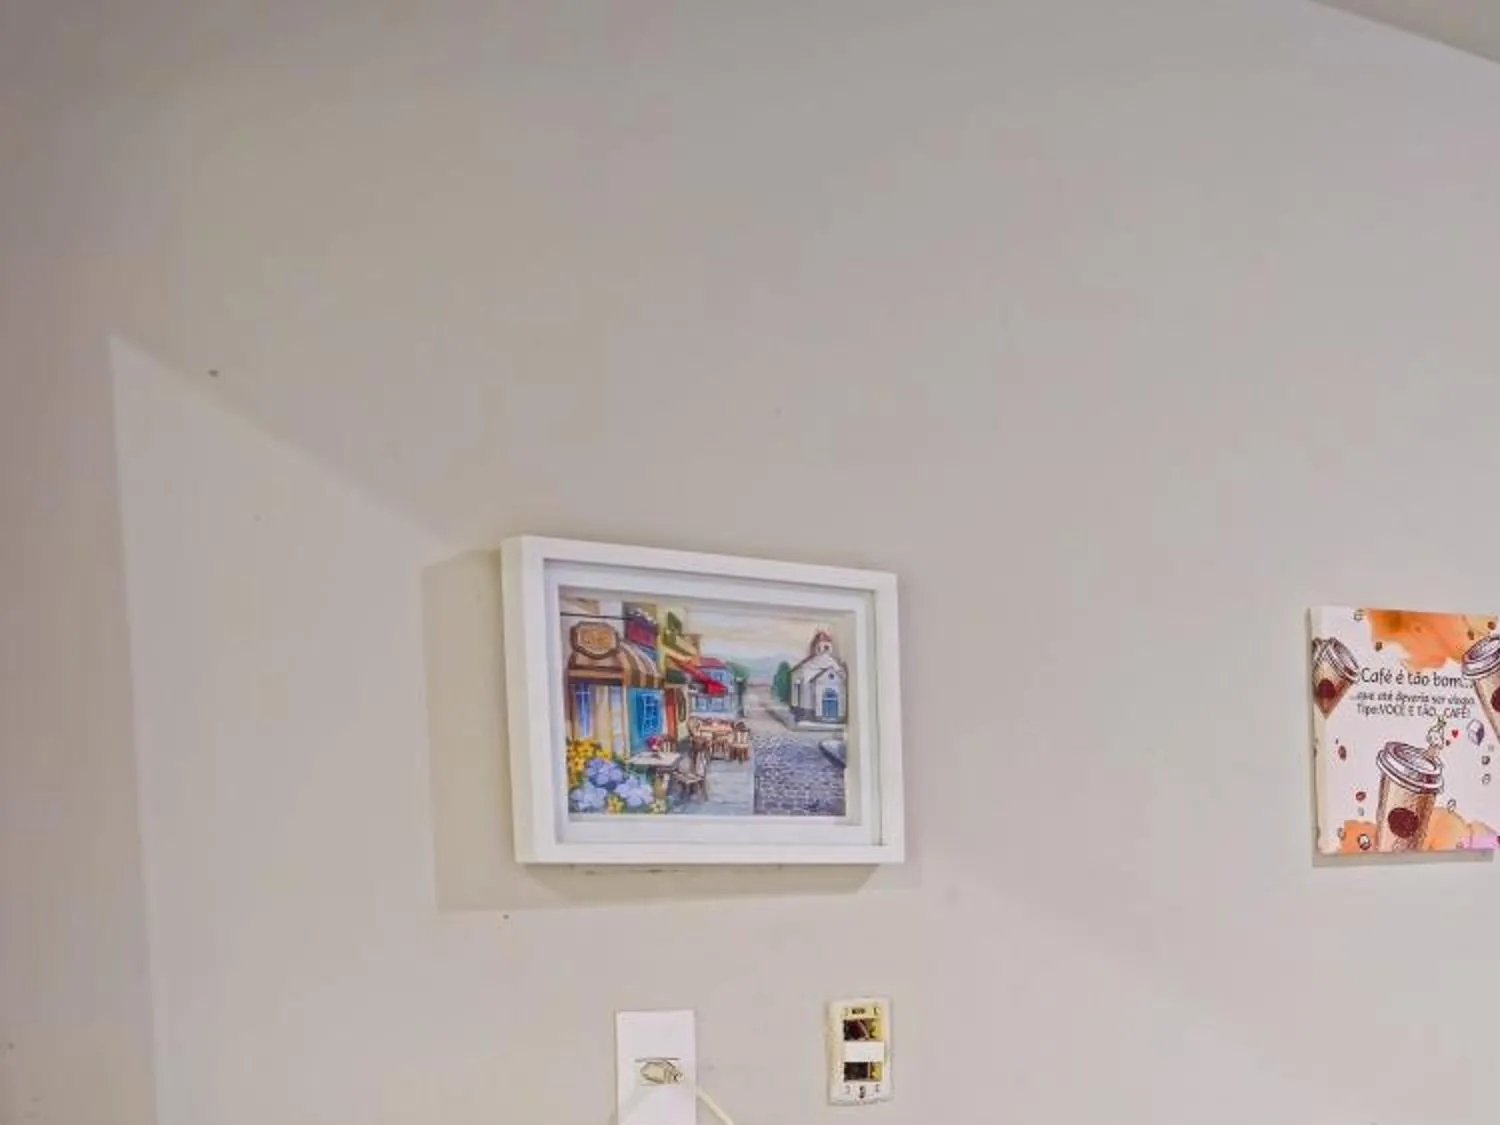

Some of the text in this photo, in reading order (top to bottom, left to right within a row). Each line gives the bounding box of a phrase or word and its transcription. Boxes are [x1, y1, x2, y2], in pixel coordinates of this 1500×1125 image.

[1361, 667, 1392, 685] Café
[1395, 669, 1404, 685] é
[1407, 671, 1430, 686] tão
